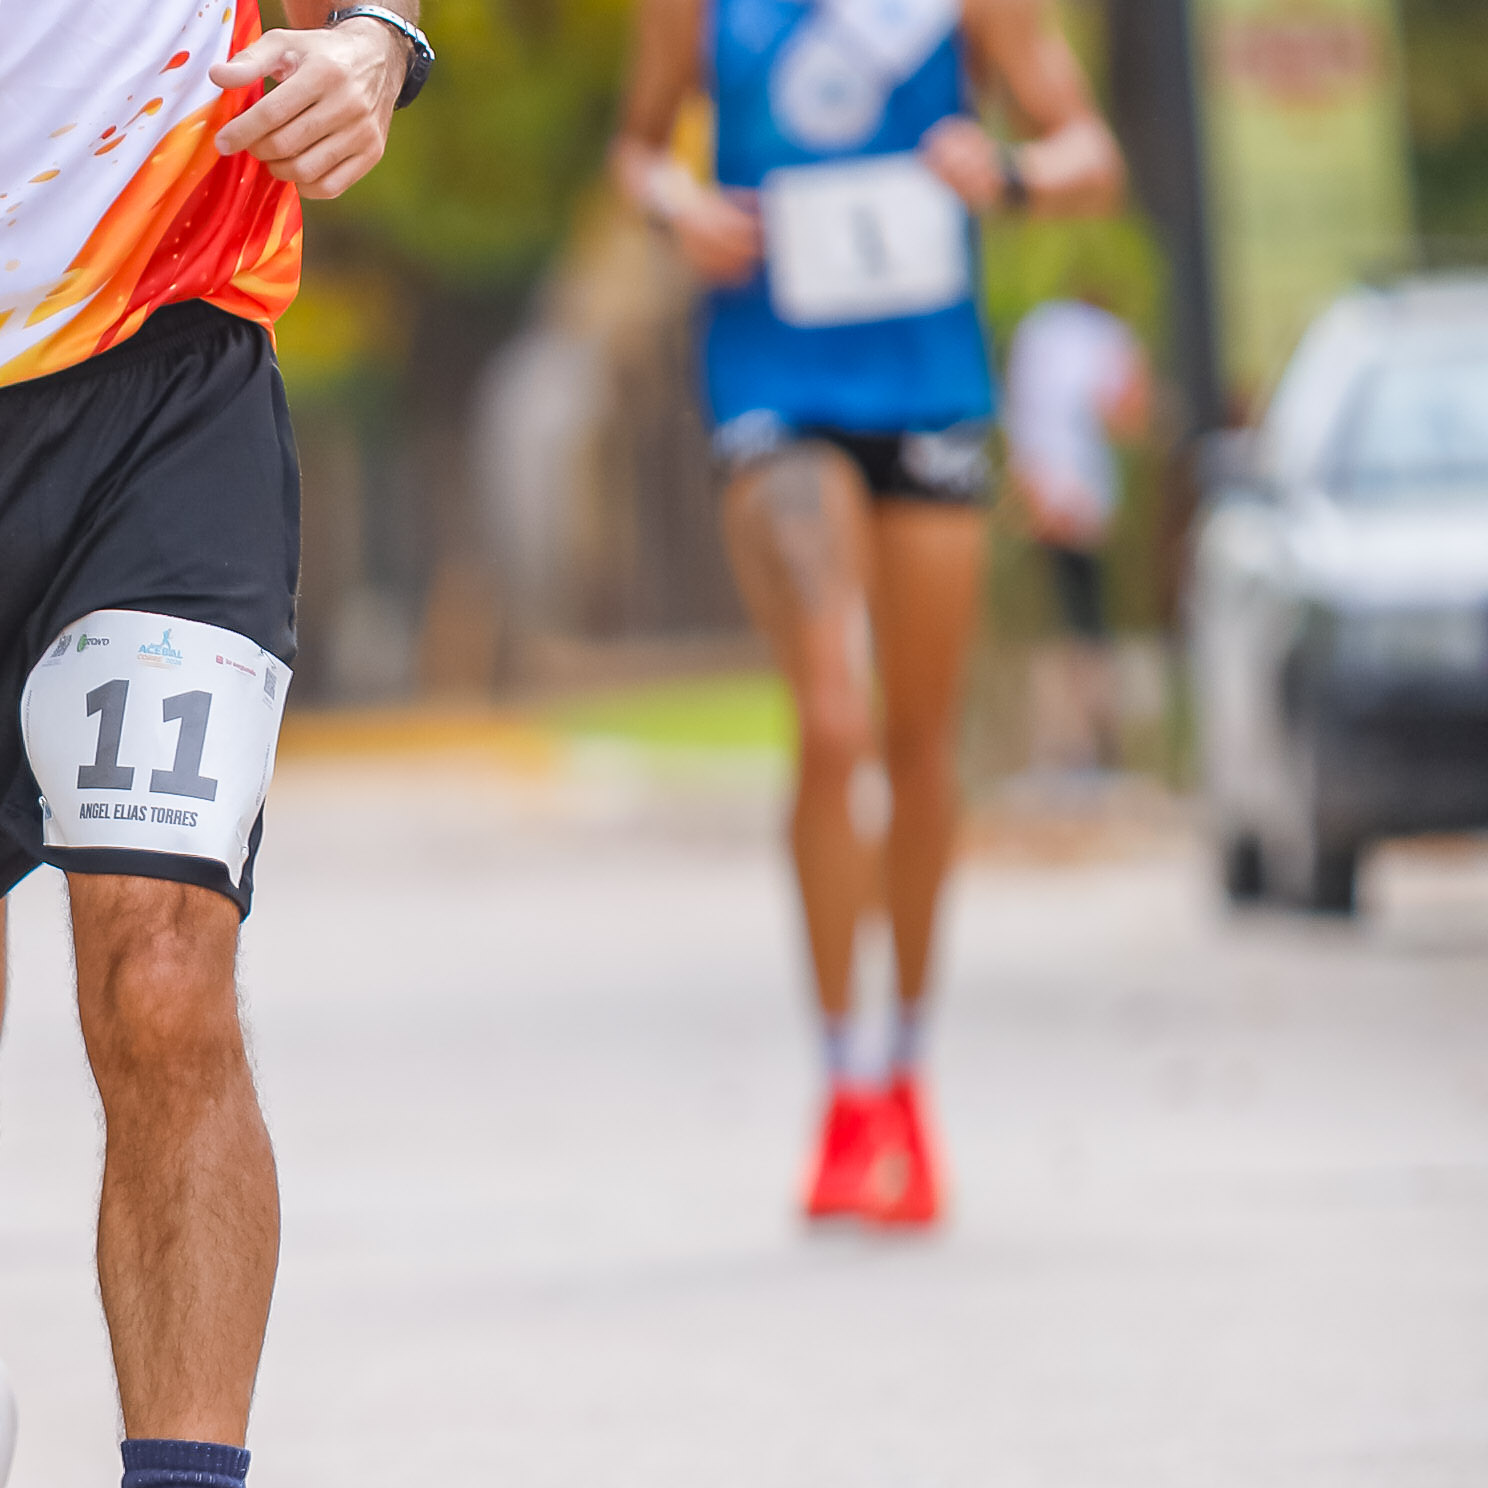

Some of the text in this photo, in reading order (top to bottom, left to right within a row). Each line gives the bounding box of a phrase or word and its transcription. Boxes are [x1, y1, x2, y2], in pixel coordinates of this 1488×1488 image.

[77, 679, 218, 801] 11
[79, 803, 198, 827] ANGEL ELIAS TORRES
